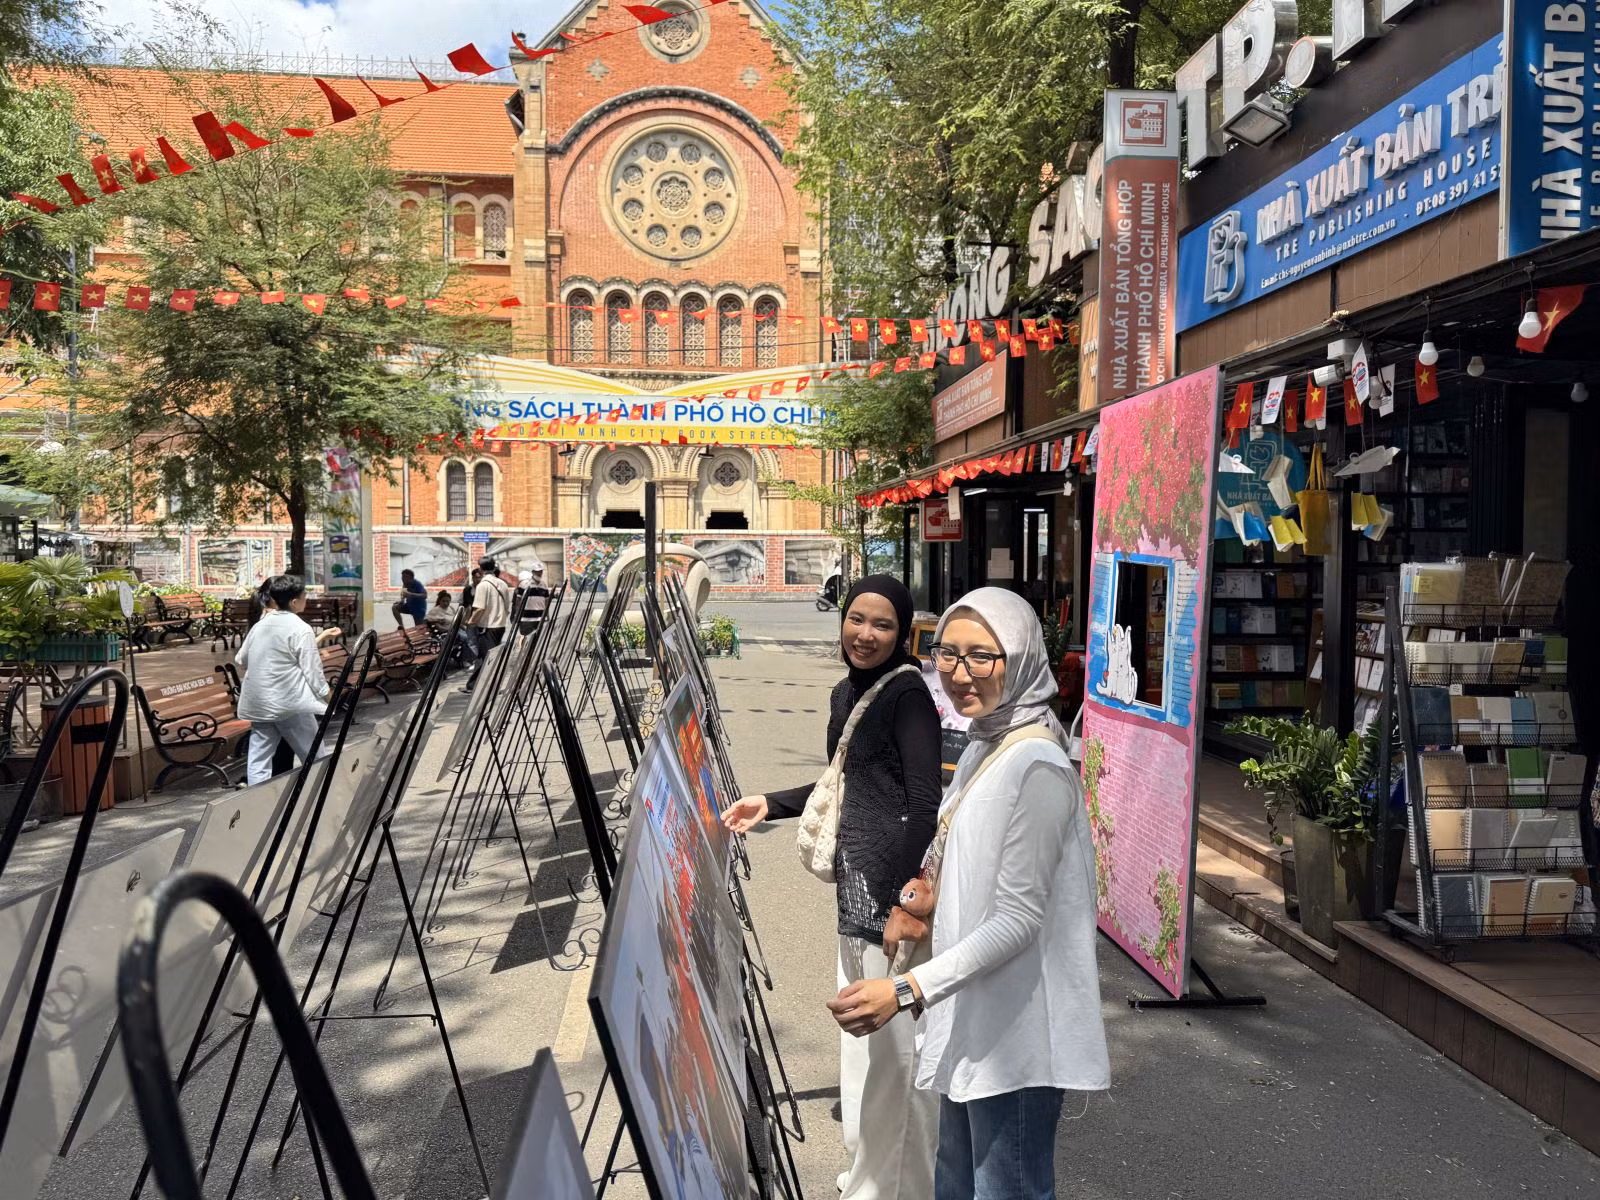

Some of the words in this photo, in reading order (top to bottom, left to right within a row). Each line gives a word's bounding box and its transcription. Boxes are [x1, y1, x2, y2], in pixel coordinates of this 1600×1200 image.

[1529, 43, 1585, 155] XUẤT
[1256, 181, 1303, 245] NHÀ
[1305, 137, 1373, 218] XUẤT
[1374, 104, 1440, 180] BẢN
[1449, 179, 1469, 201] 391
[1473, 170, 1487, 188] 41
[1118, 179, 1135, 214] HỢP
[1141, 182, 1156, 225] MINH
[1162, 182, 1171, 214] HOUSE
[1276, 238, 1298, 262] TRE
[1309, 181, 1407, 245] PUBLISHING
[1424, 137, 1491, 189] HOUSE
[1110, 221, 1132, 269] TỔNG
[1140, 229, 1154, 257] CHÍ
[1161, 215, 1169, 269] PUBLISHING
[1110, 271, 1130, 303] BẢN
[1159, 269, 1168, 311] GENERAL
[1136, 291, 1152, 328] PHỐ
[1158, 311, 1167, 332] CITY
[1110, 313, 1129, 350] XUẤT
[1157, 332, 1166, 361] MINH
[1110, 355, 1127, 389] NHÀ
[1133, 331, 1151, 390] THÀNH
[1157, 361, 1165, 377] CHI
[508, 396, 574, 419] SÁCH
[582, 398, 666, 421] THÀNH
[674, 400, 724, 422] PHỐ
[732, 401, 766, 423] HỒ
[539, 426, 564, 437] CI
[578, 427, 617, 437] MINH
[630, 428, 665, 438] CITY
[730, 430, 786, 441] STREET
